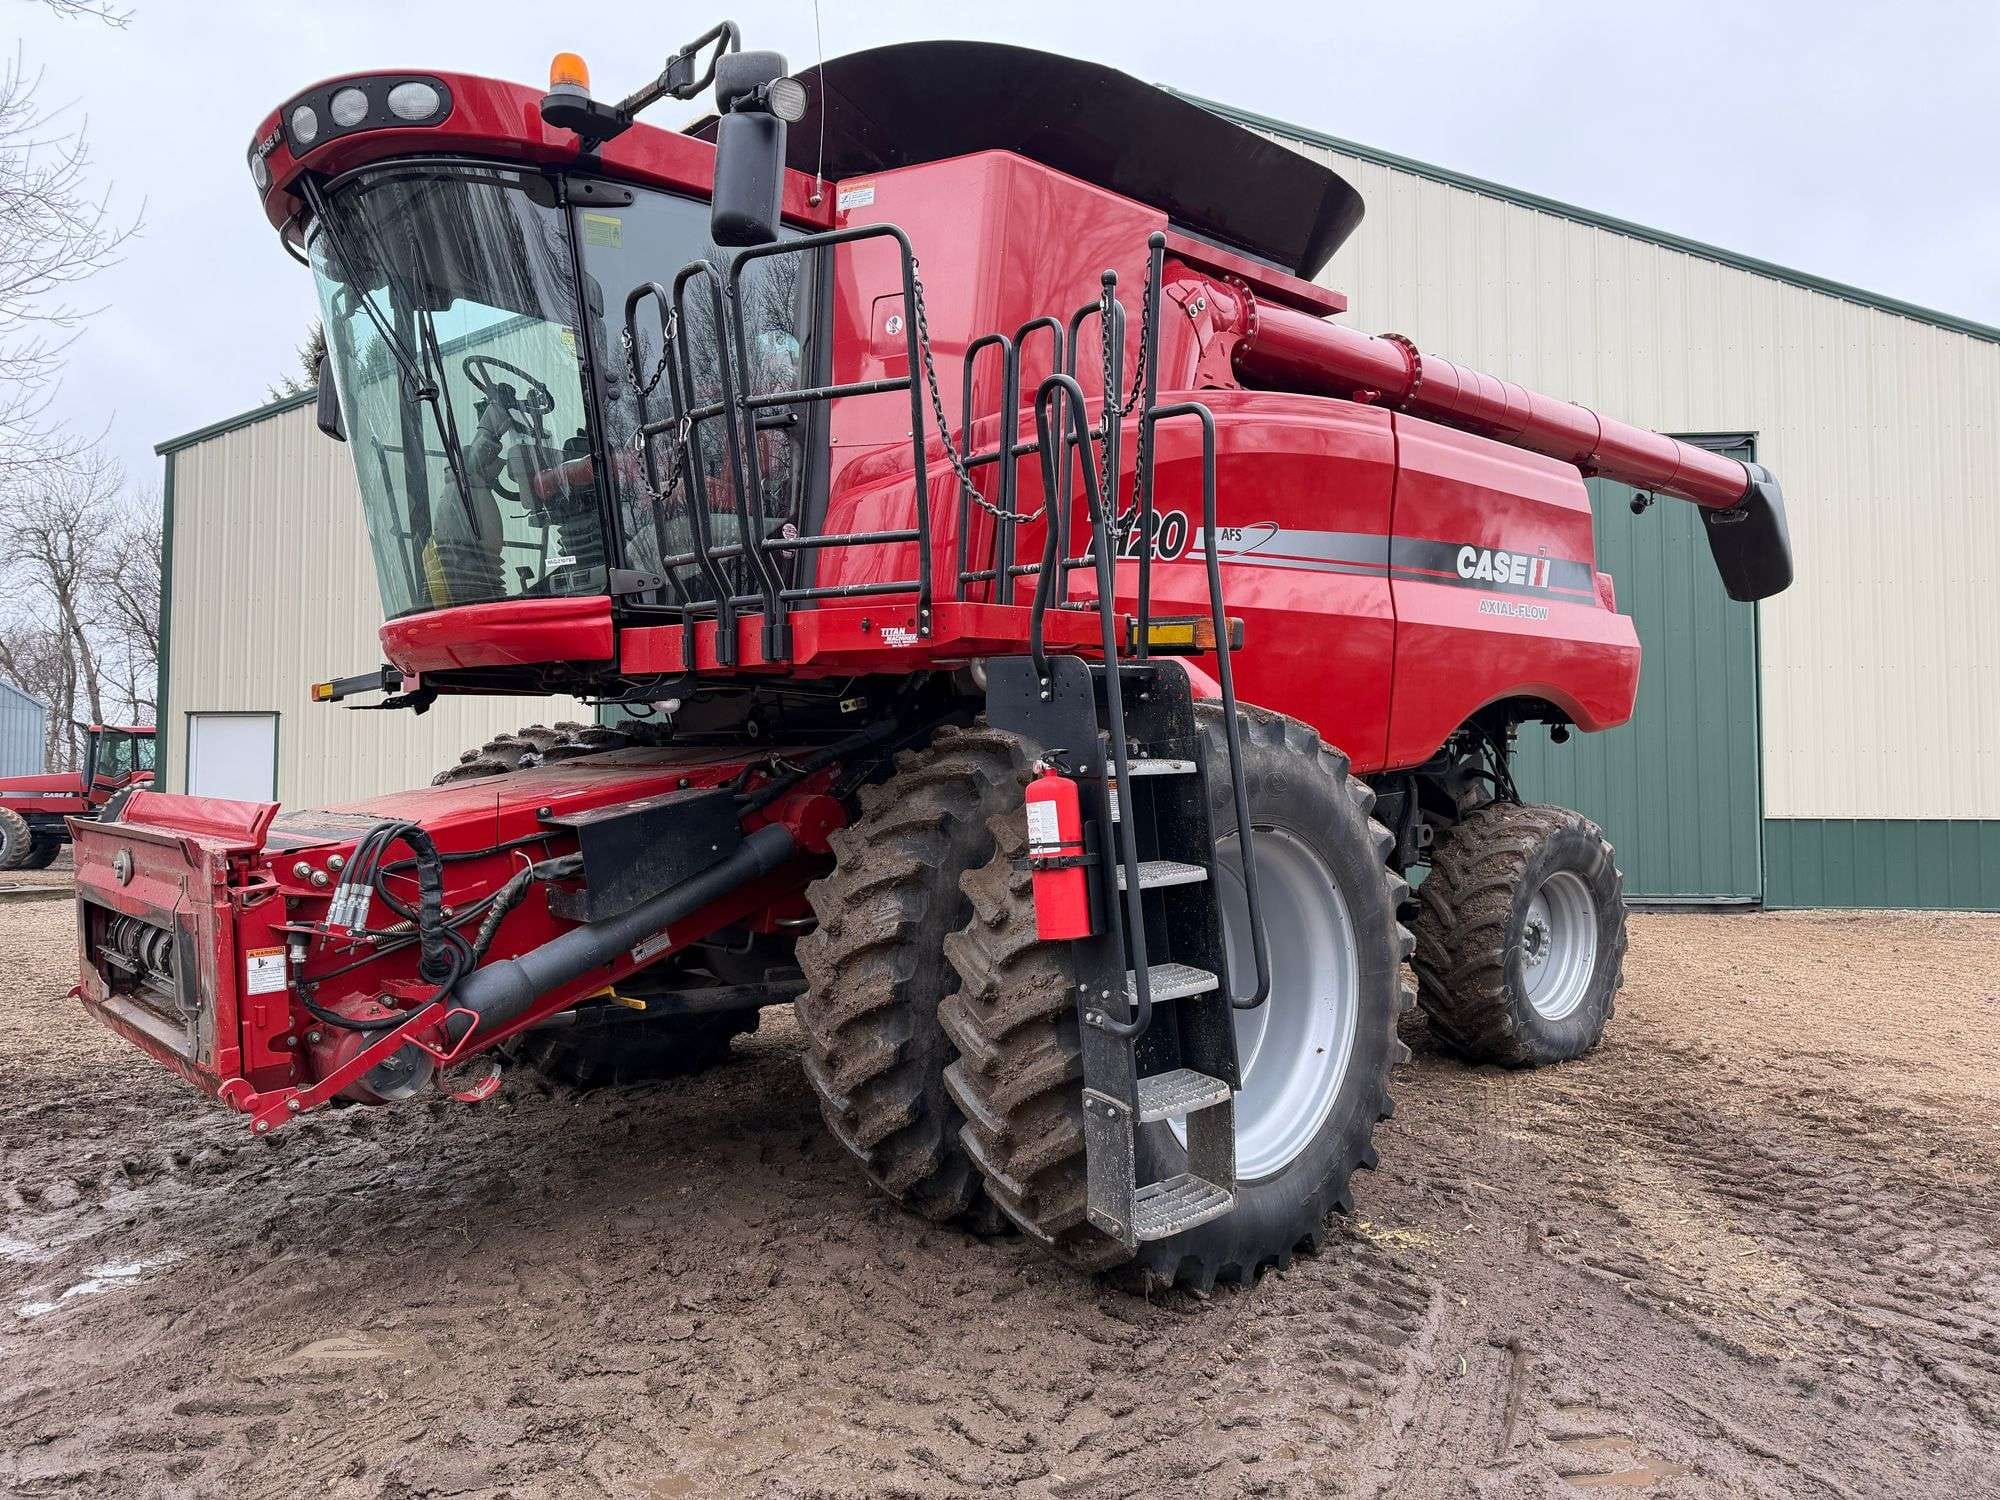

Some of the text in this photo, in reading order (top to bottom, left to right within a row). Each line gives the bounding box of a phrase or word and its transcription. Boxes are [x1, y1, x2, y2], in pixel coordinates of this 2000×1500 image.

[257, 134, 275, 158] CASE
[1221, 528, 1242, 542] AFS
[1457, 545, 1528, 585] CASE
[1479, 599, 1548, 620] AXIAL-FLOW
[880, 626, 906, 637] TITAN
[42, 791, 65, 799] CASE
